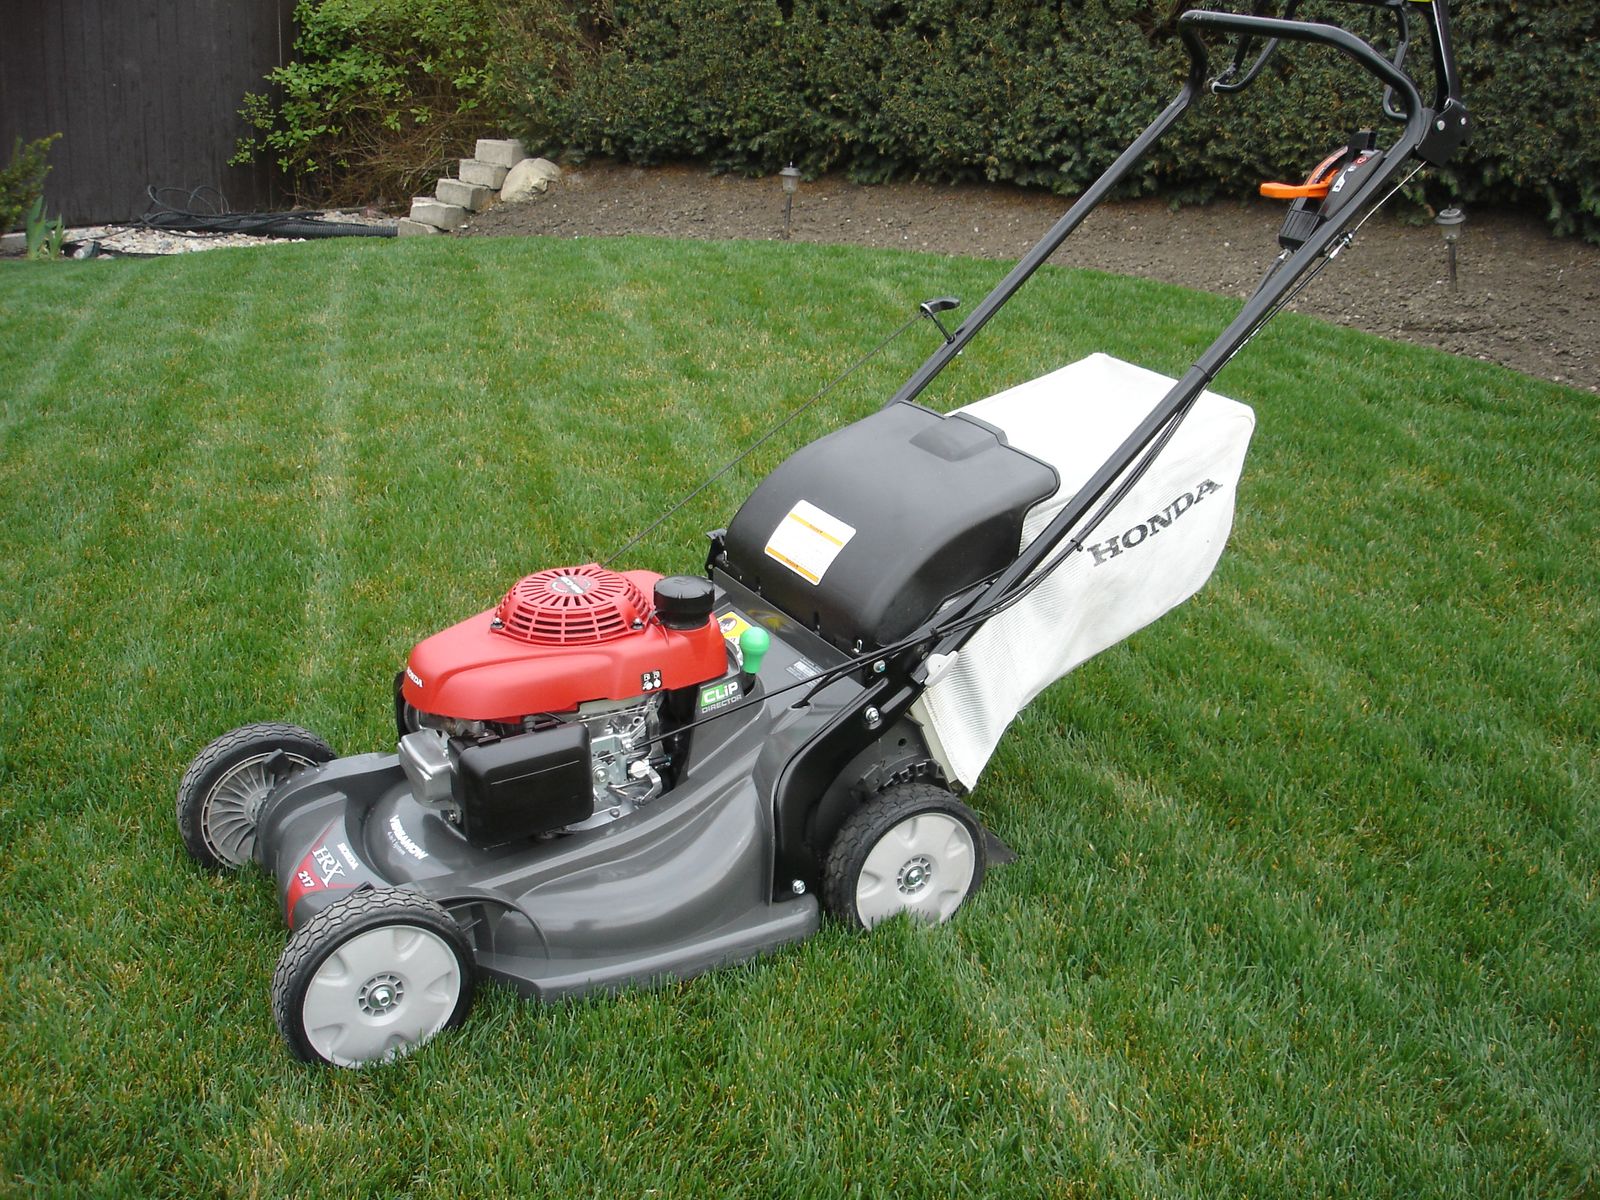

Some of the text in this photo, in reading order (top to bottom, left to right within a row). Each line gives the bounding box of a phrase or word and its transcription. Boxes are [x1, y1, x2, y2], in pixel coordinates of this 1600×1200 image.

[1086, 478, 1223, 567] HONDA
[701, 694, 742, 714] DIRECTOR
[297, 870, 315, 887] 217
[312, 845, 346, 888] HRX
